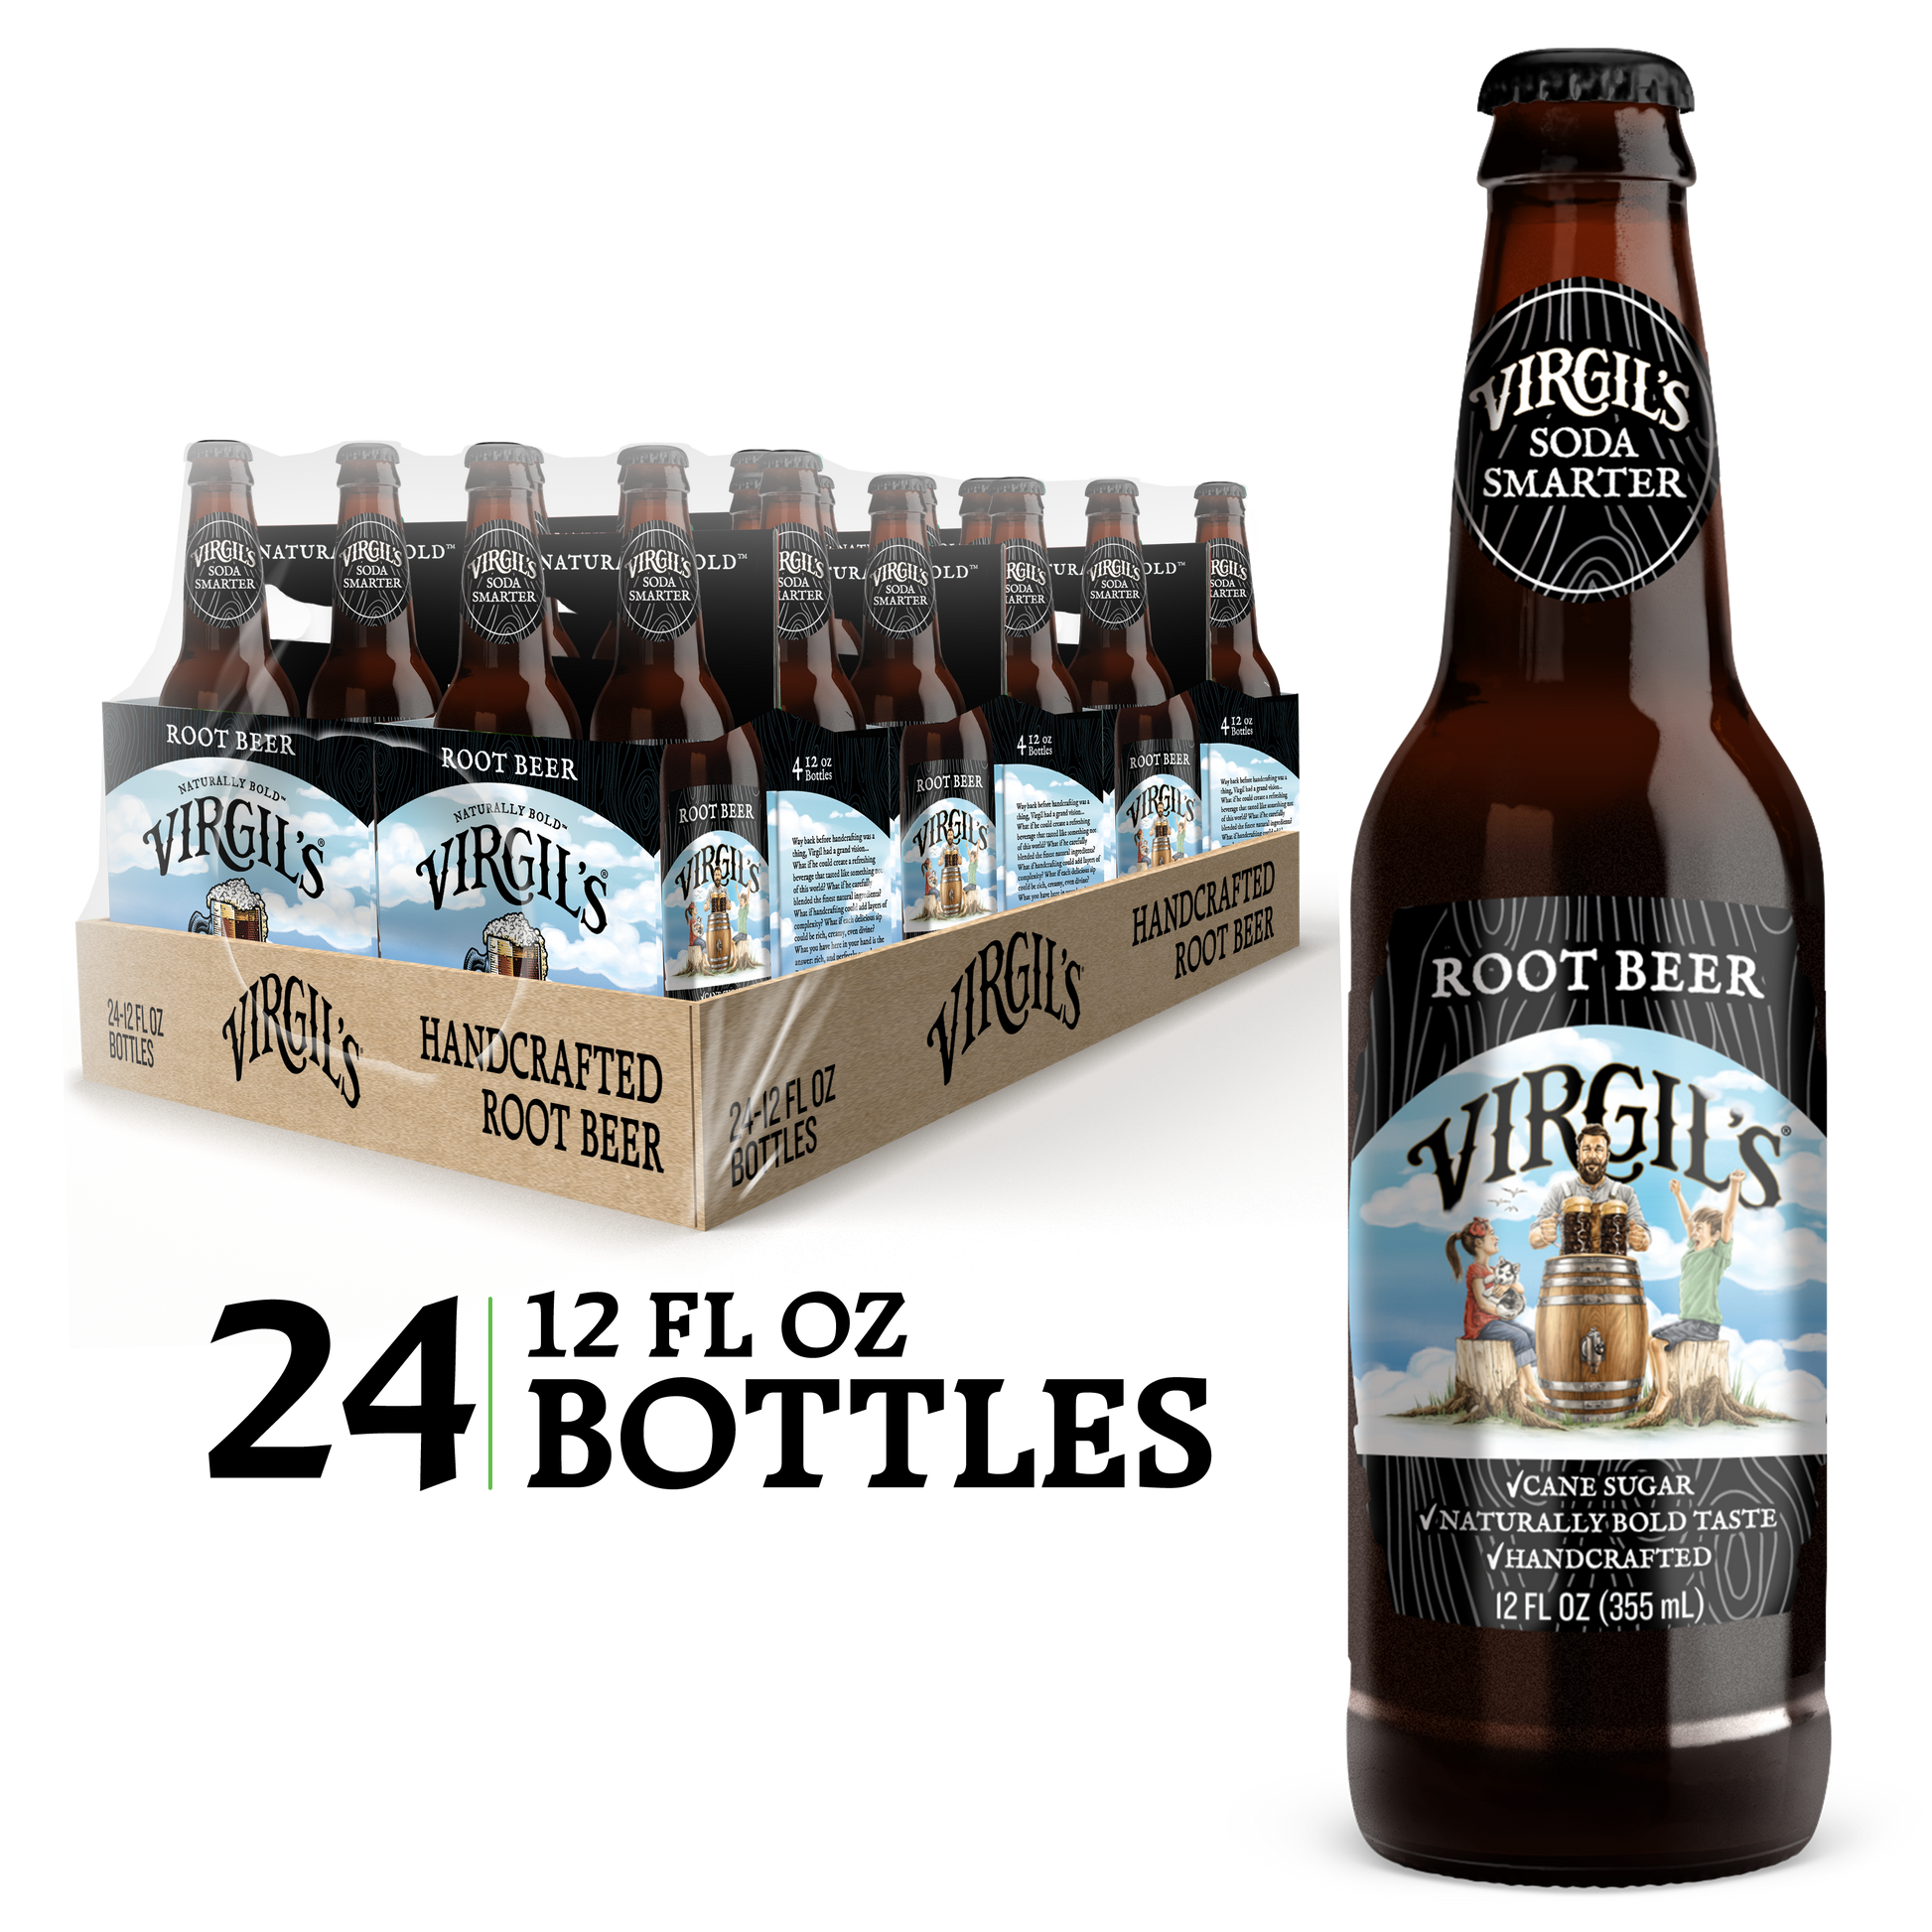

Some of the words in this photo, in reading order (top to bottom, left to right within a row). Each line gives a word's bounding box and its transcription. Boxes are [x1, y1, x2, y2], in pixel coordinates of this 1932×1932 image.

[1468, 347, 1690, 432] VIRGIL'S
[1529, 427, 1638, 458] SODA
[1483, 467, 1687, 497] SMARTER
[190, 539, 256, 568] VIRGIL'S
[339, 540, 402, 568] VIRGIL'S
[624, 549, 691, 579] VIRGIL'S
[208, 566, 241, 576] SODA
[356, 565, 388, 576] SODA
[468, 549, 537, 580] VIRGIL'S
[779, 551, 824, 579] RGIL'S
[870, 562, 929, 587] VIRGIL'S
[1007, 562, 1045, 586] RGIL'S
[1086, 559, 1141, 582] VIRGIL'S
[1211, 559, 1247, 580] RGIL'S
[196, 579, 255, 590] SMARTER
[344, 578, 402, 589] SMARTER
[486, 577, 521, 589] SODA
[642, 577, 676, 588] SODA
[779, 577, 810, 588] SODA
[886, 585, 915, 595] SODA
[1006, 584, 1034, 593] SODA
[1101, 580, 1128, 589] SODA
[472, 591, 536, 603] SMARTER
[629, 590, 691, 601] SMARTER
[779, 590, 824, 601] ARTER
[874, 596, 928, 606] SMARTER
[1006, 595, 1045, 604] ARTER
[1090, 590, 1140, 600] SMARTER
[1211, 589, 1247, 598] ARTER
[1221, 717, 1229, 736] 4
[1231, 727, 1253, 736] Bottles
[167, 724, 228, 749] ROOT
[235, 731, 296, 756] BEER
[1017, 735, 1027, 756] 4
[1029, 735, 1039, 744] 12
[1028, 746, 1052, 757] Bottles
[1130, 754, 1161, 769] ROOT
[1163, 753, 1190, 765] BEER
[441, 747, 507, 773] ROOT
[514, 755, 578, 780] BEER
[792, 757, 803, 780] 4
[805, 757, 818, 767] 12
[821, 758, 833, 767] oz
[178, 775, 246, 794] NATURALLY
[805, 768, 833, 781] Bottles
[916, 775, 951, 792] ROOT
[953, 773, 983, 788] BEER
[453, 802, 525, 823] NATURALLY
[679, 804, 719, 823] ROOT
[721, 803, 755, 820] BEER
[1126, 784, 1195, 828] VIRGIL'S
[792, 837, 803, 847] Way
[816, 835, 831, 844] before
[832, 833, 862, 843] handcrafting
[912, 808, 988, 858] VIRGIL'S
[823, 846, 832, 855] had
[837, 845, 851, 856] grand
[675, 844, 759, 901] VIRGIL'S
[808, 860, 812, 869] if
[1132, 861, 1275, 946] HANDCRAFTED
[1174, 923, 1228, 980] ROOT
[1233, 905, 1274, 954] BEER
[1432, 948, 1597, 998] ROOT
[1615, 949, 1764, 999] BEER
[107, 998, 134, 1032] 24-12
[135, 1004, 148, 1035] FL
[149, 1007, 164, 1036] OZ
[109, 1032, 154, 1067] BOTTLES
[420, 1016, 662, 1104] HANDCRAFTED
[729, 1085, 781, 1143] 24-12
[785, 1077, 807, 1119] FL
[811, 1063, 836, 1107] OZ
[482, 1088, 570, 1151] ROOT
[581, 1108, 664, 1173] BEER
[731, 1115, 817, 1187] BOTTLES
[1523, 1475, 1597, 1496] CANE
[1603, 1475, 1695, 1496] SUGAR
[1440, 1510, 1606, 1533] NATURALLY
[1612, 1510, 1687, 1533] BOLD
[1693, 1508, 1778, 1530] TASTE
[1505, 1547, 1713, 1569] HANDCRAFTED
[1496, 1591, 1518, 1619] 12
[1525, 1591, 1551, 1620] FL
[1559, 1591, 1590, 1620] OZ
[1599, 1589, 1653, 1626] (355
[1661, 1587, 1705, 1624] mL)
